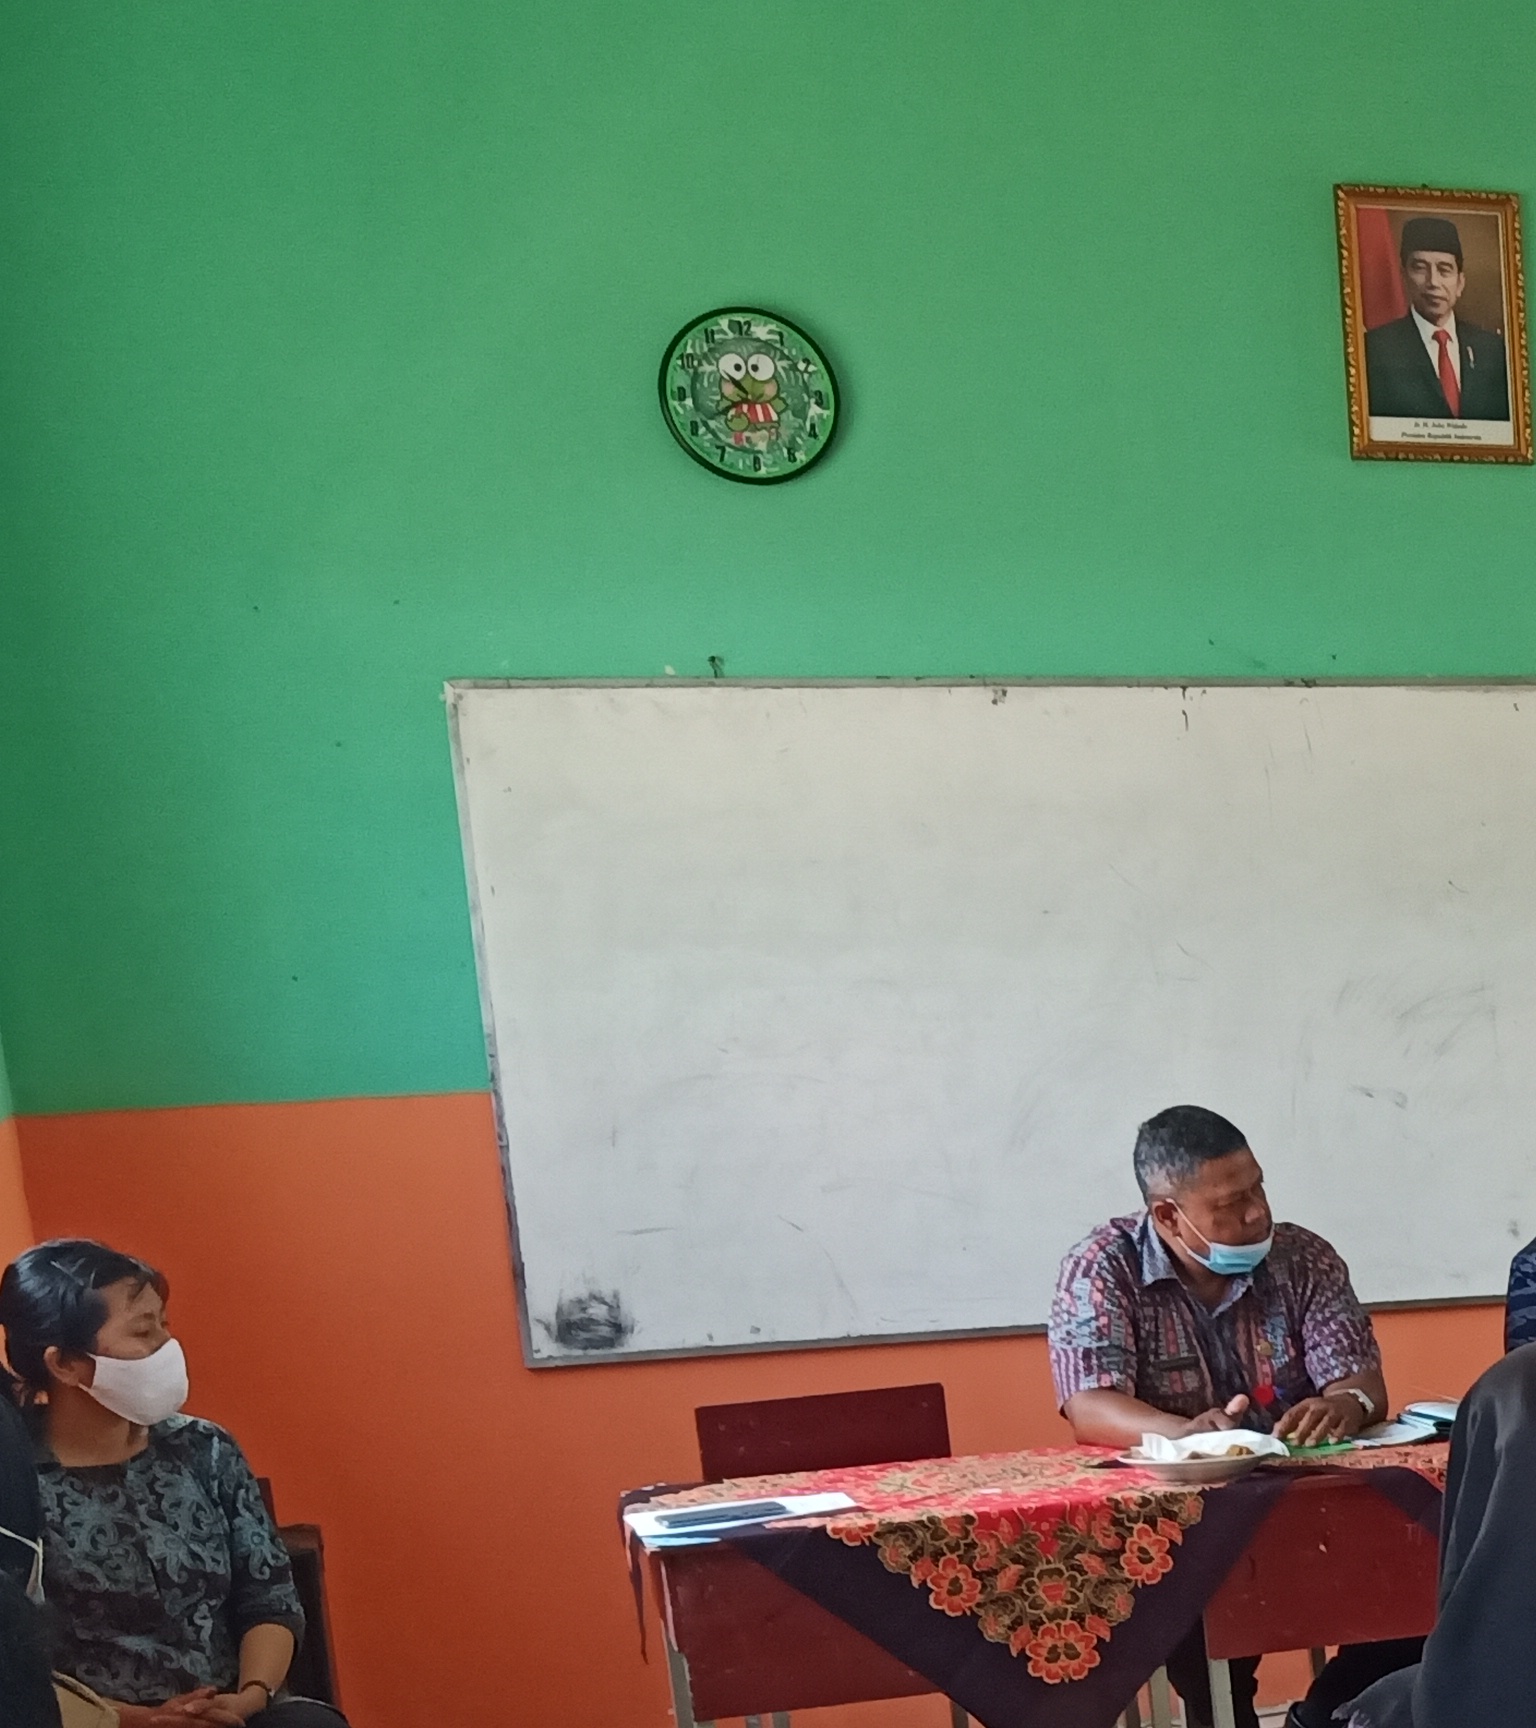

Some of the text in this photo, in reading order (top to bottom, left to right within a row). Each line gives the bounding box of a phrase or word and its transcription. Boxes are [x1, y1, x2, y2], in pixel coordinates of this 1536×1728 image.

[704, 328, 715, 344] 11
[738, 320, 752, 336] 12
[681, 353, 694, 369] 10
[807, 423, 819, 440] 4
[715, 446, 726, 462] 7
